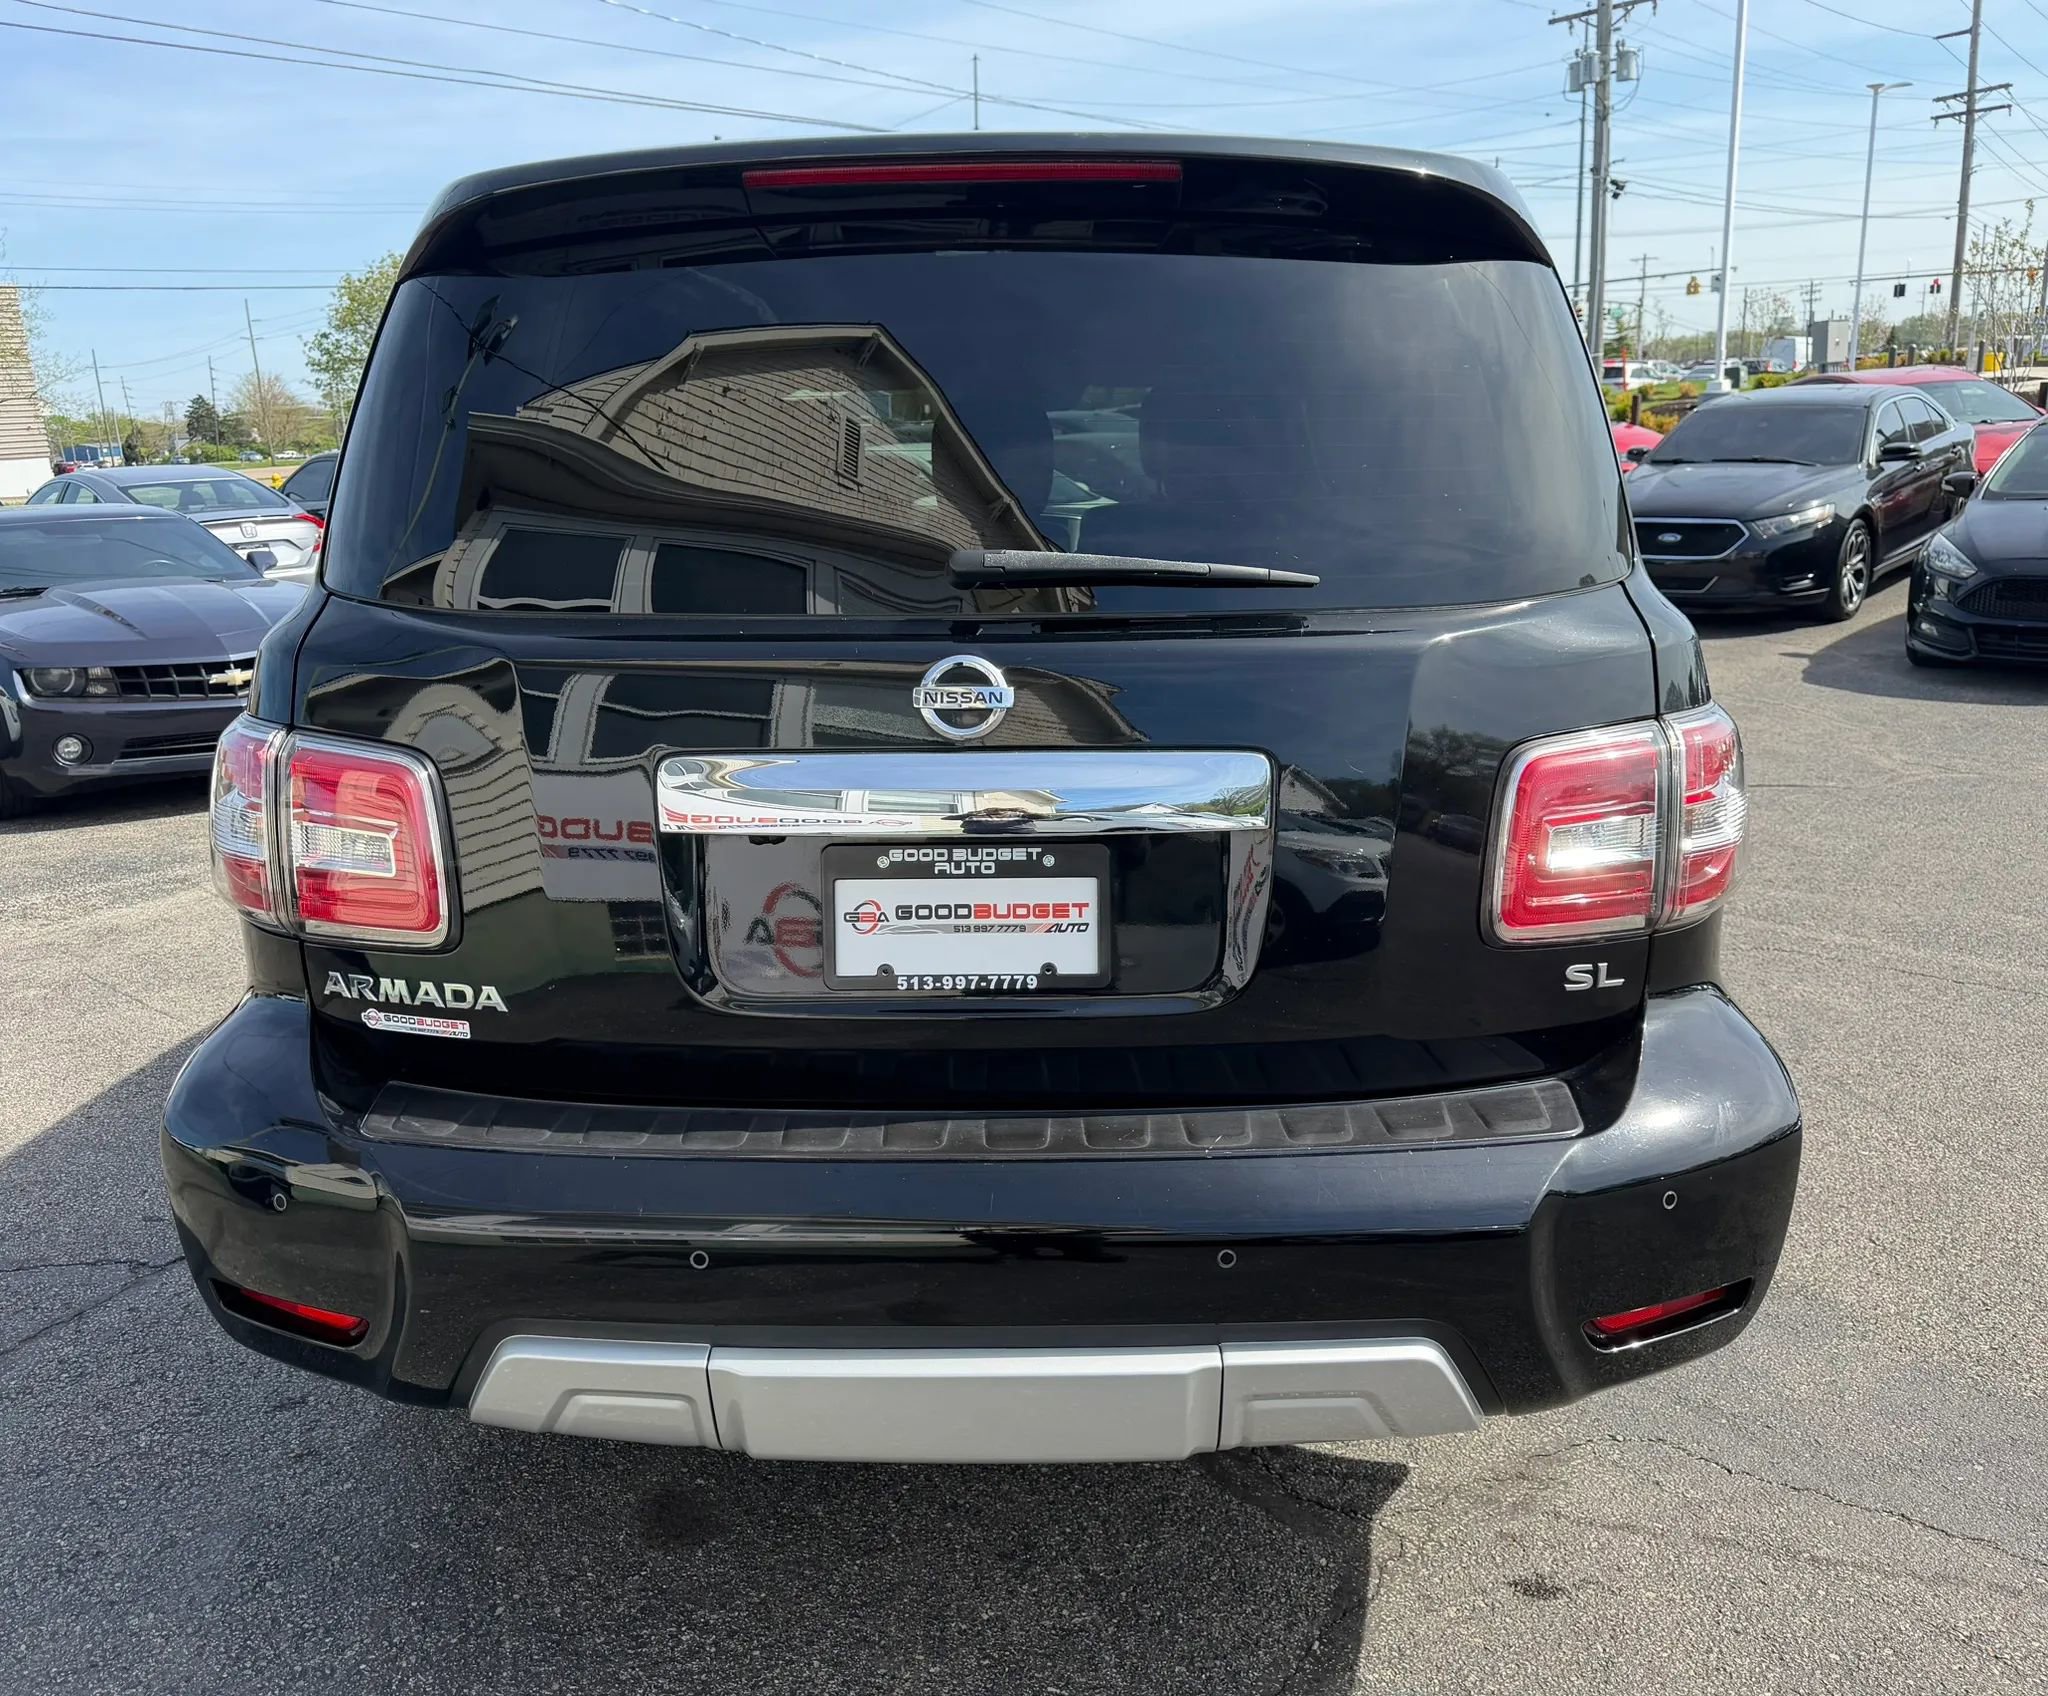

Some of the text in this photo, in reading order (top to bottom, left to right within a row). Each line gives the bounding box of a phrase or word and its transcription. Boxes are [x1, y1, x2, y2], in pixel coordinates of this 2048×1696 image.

[924, 691, 1003, 704] NISSAN
[889, 847, 1042, 861] GOOD BUDGET
[934, 861, 996, 875] AUTO
[843, 912, 890, 923] GBA
[895, 903, 1090, 920] GOODBUDGET
[953, 922, 1090, 934] 513 997 7779 AUTO
[897, 975, 1038, 990] 513-997-7779
[1564, 962, 1625, 991] SL
[323, 971, 509, 1013] ARMADA
[383, 1014, 467, 1030] GOODBUDGET
[449, 1030, 469, 1038] AUTO
